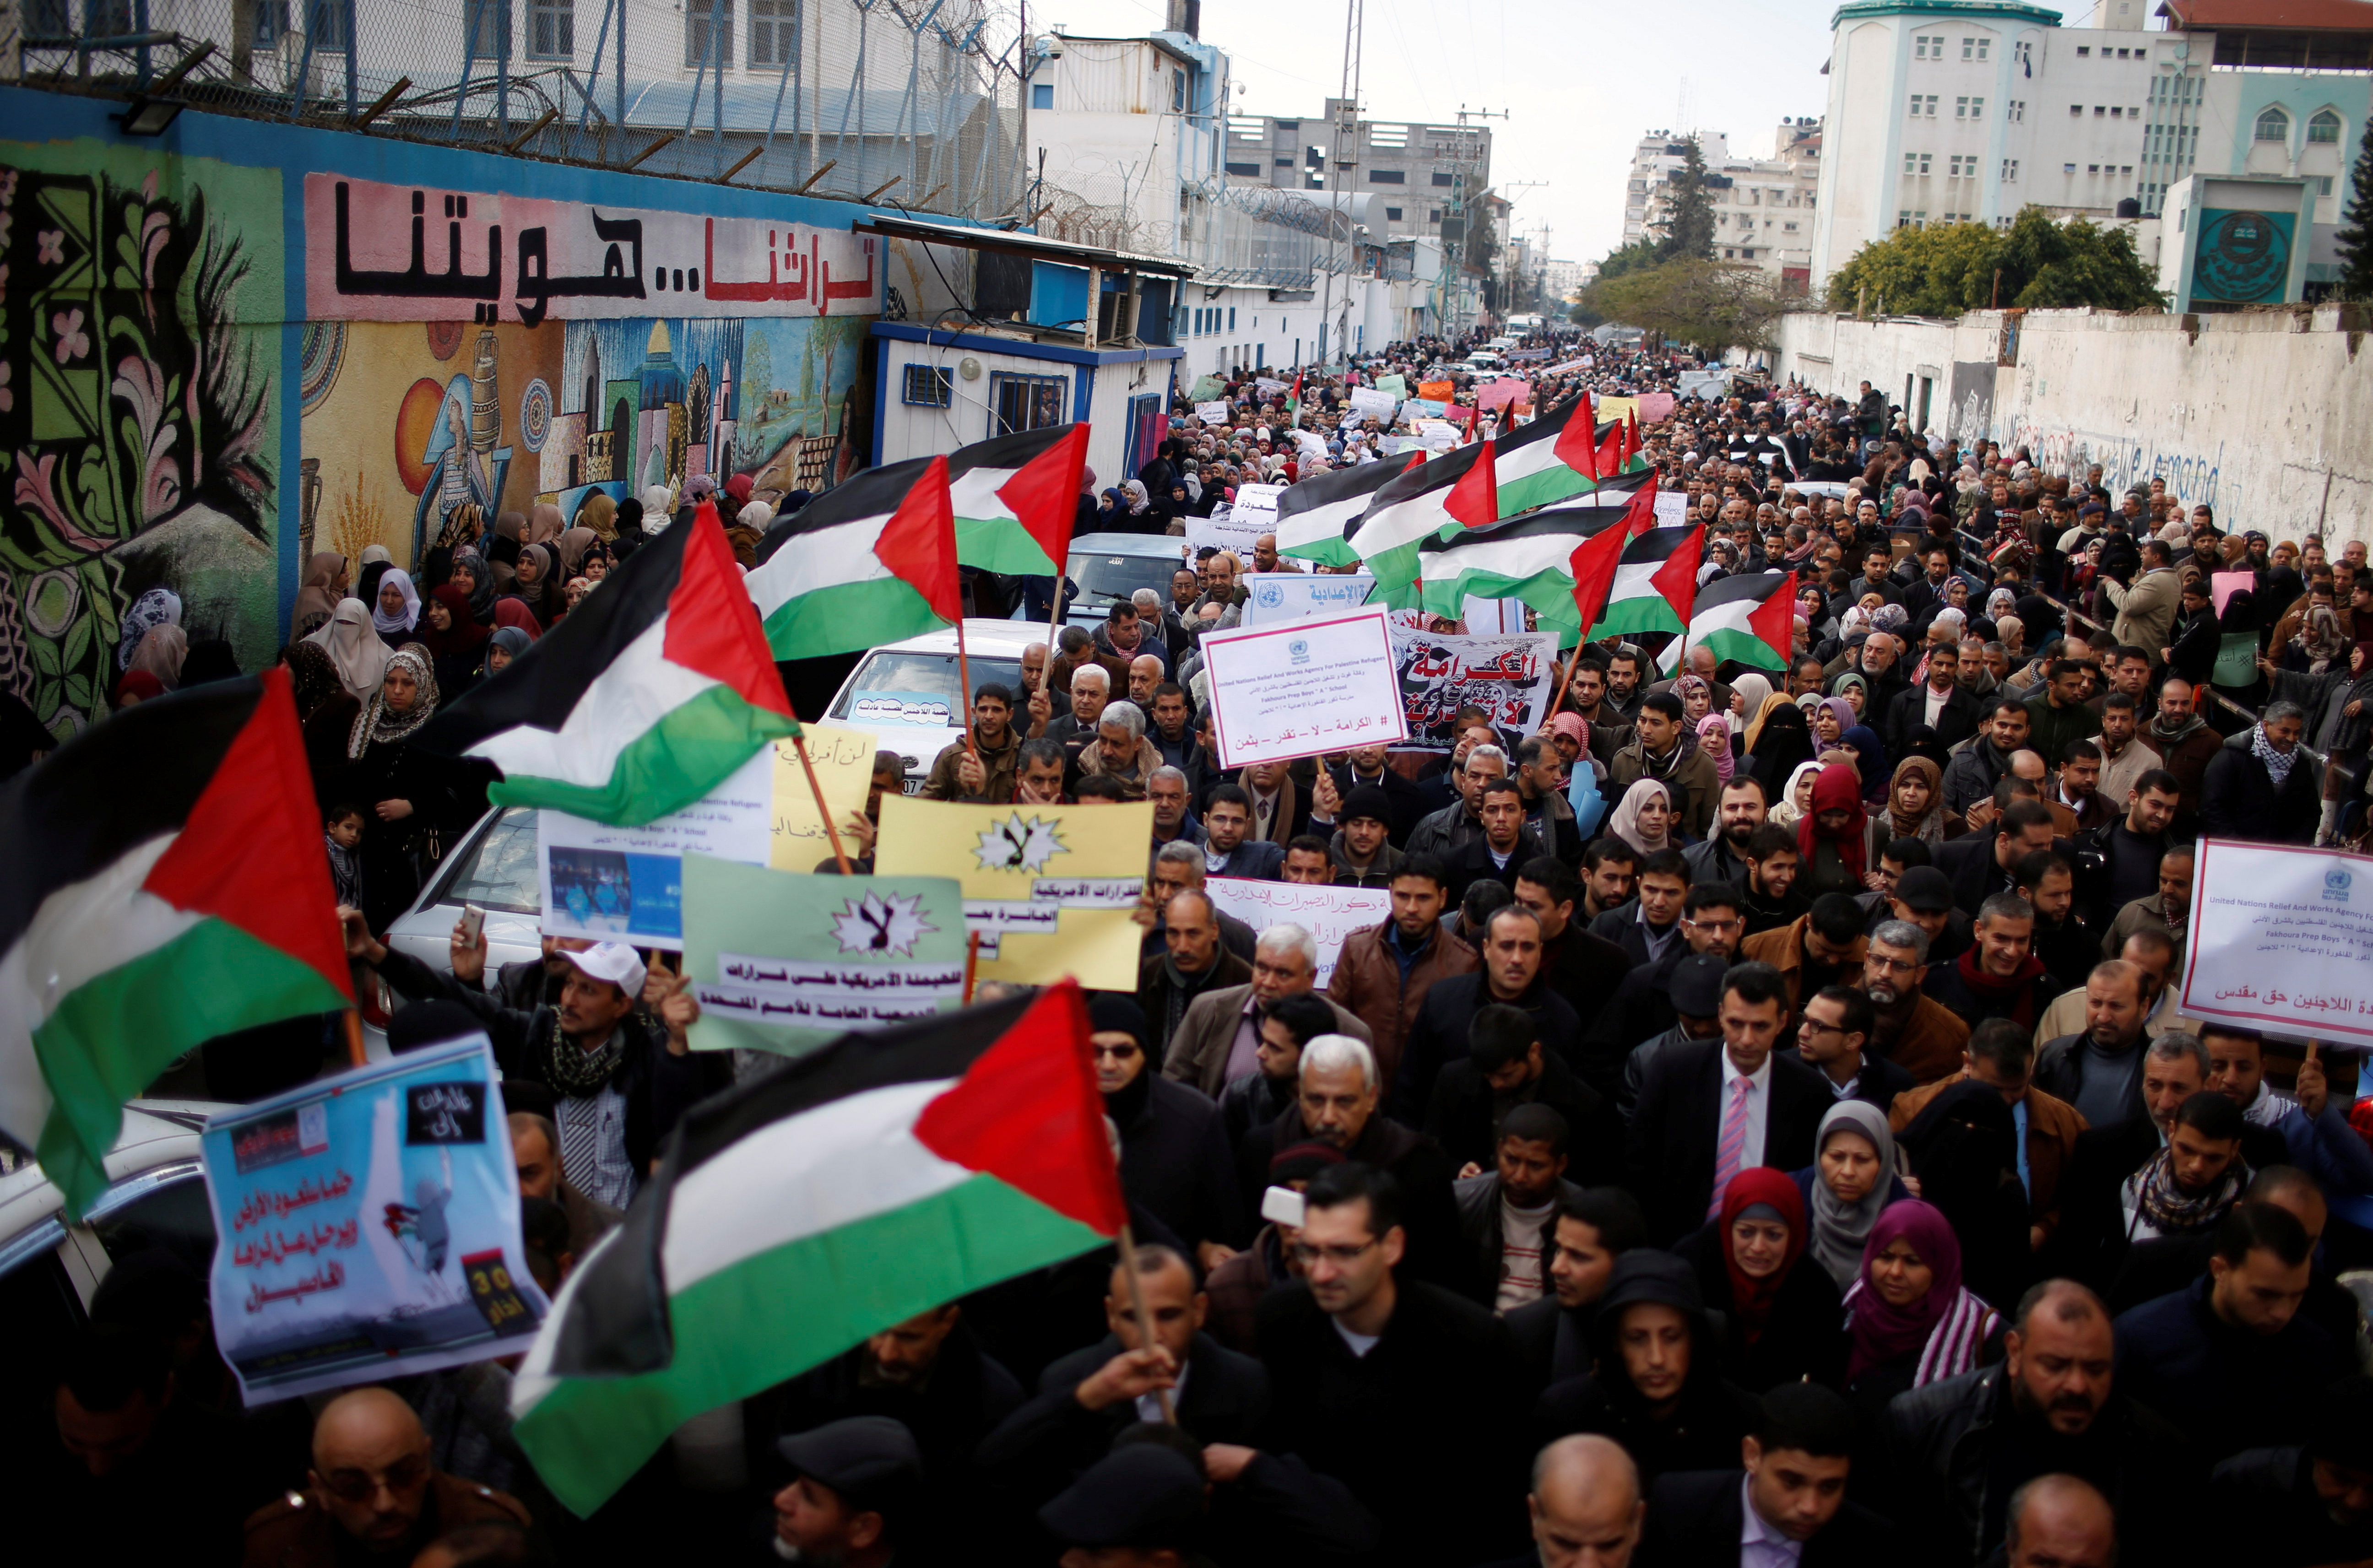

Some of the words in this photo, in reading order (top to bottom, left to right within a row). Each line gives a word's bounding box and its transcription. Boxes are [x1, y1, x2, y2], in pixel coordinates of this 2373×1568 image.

[336, 181, 646, 333] هويتنا
[1658, 514, 1679, 527] RWA
[1193, 542, 1230, 552] الأونوا
[1108, 556, 1124, 566] الله
[1309, 584, 1357, 606] الإعدادية
[1304, 666, 1324, 674] Agency
[1334, 660, 1360, 668] Palestine
[1360, 655, 1386, 664] Refugees
[1413, 646, 1537, 686] الكرامة
[1261, 694, 1286, 703] Fakhoura
[903, 708, 931, 716] اللاجئين
[932, 708, 949, 718] قضية
[1406, 692, 1428, 729] بث
[1429, 697, 1497, 728] تدر
[1504, 700, 1524, 725] لا
[1311, 725, 1319, 735] لا
[1336, 716, 1371, 731] الكرامة
[1235, 734, 1258, 750] بثمن
[1275, 729, 1295, 744] تقدر
[839, 741, 866, 765] لن
[1002, 827, 1034, 865] لا
[1034, 881, 1089, 898] الأمريكية
[2322, 888, 2349, 897] unrwa
[964, 909, 992, 921] بح
[998, 907, 1056, 922] الجائرة
[2209, 896, 2235, 905] United
[2237, 898, 2267, 908] Nations
[2269, 902, 2291, 910] Relief
[2309, 905, 2334, 914] Works
[2335, 907, 2364, 920] Agency
[859, 904, 894, 949] لا
[2271, 916, 2294, 925] بالشرق
[2329, 921, 2354, 931] اللاجئين
[2266, 930, 2300, 939] Fakhoura
[2302, 932, 2319, 941] Prep
[2321, 934, 2340, 944] Boys
[2362, 941, 2373, 949] Sch
[2297, 945, 2324, 956] الإعدادية
[2326, 949, 2353, 959] الفاخورة
[726, 963, 788, 981] قرارات
[791, 970, 837, 986] على
[840, 970, 901, 989] الأمريكية
[700, 991, 758, 1010] المتحدة
[2215, 985, 2258, 1000] مقدس
[2262, 989, 2288, 1006] حق
[761, 999, 811, 1016] للأمم
[816, 1002, 867, 1019] العامة
[2293, 994, 2352, 1013] اللاجئين
[472, 1266, 510, 1296] 30
